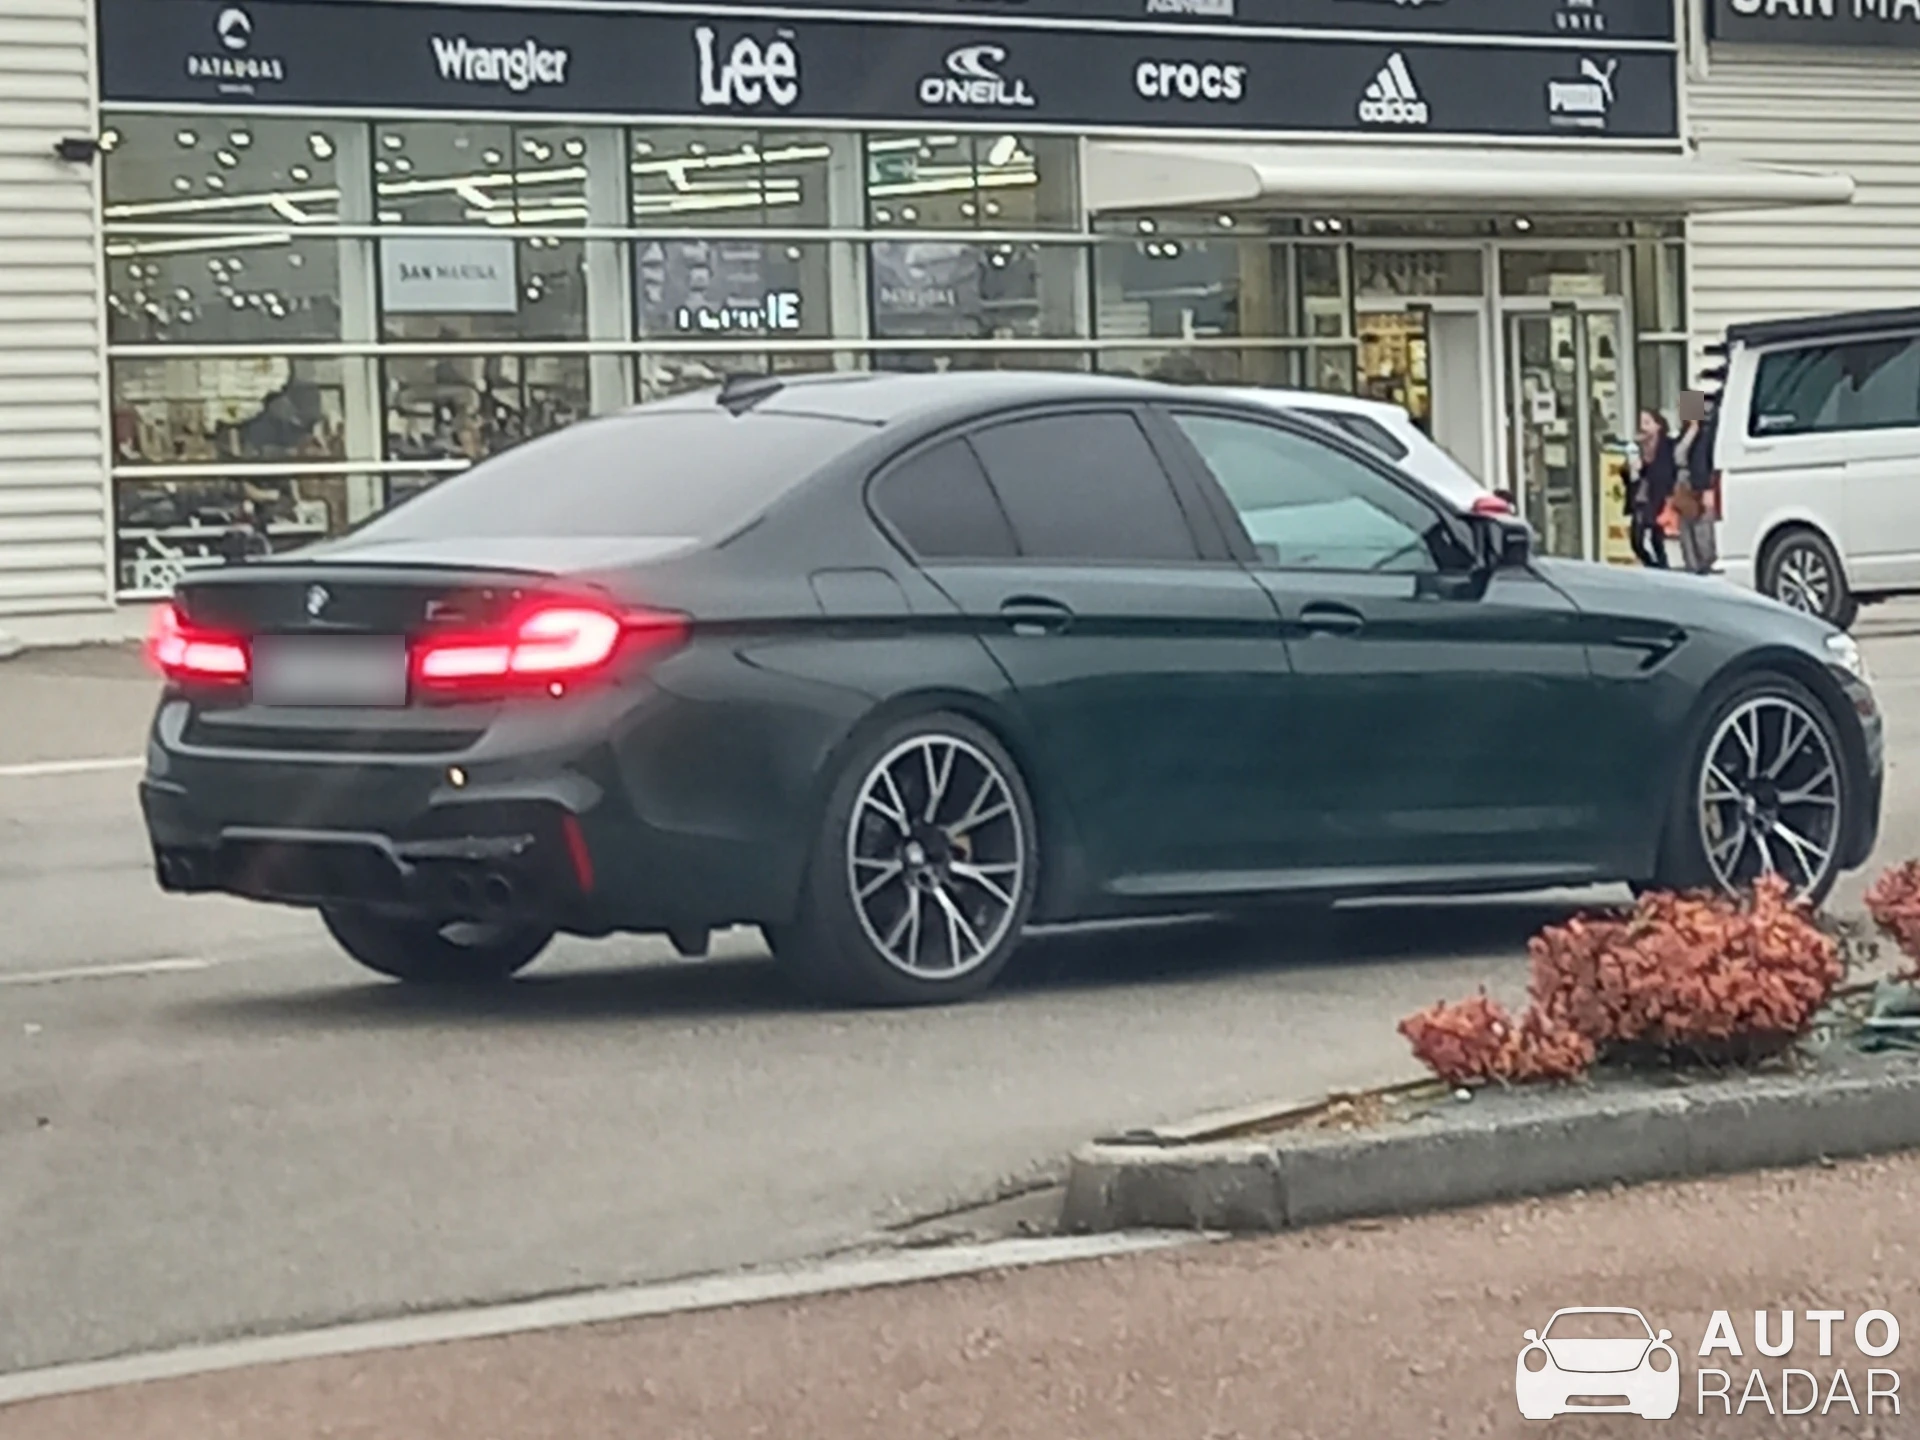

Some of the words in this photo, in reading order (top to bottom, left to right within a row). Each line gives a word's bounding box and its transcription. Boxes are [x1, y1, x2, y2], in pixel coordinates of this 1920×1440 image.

[431, 37, 567, 90] Wrangler
[695, 26, 798, 105] Lee
[1136, 62, 1242, 98] crocs
[1358, 96, 1428, 124] adidas
